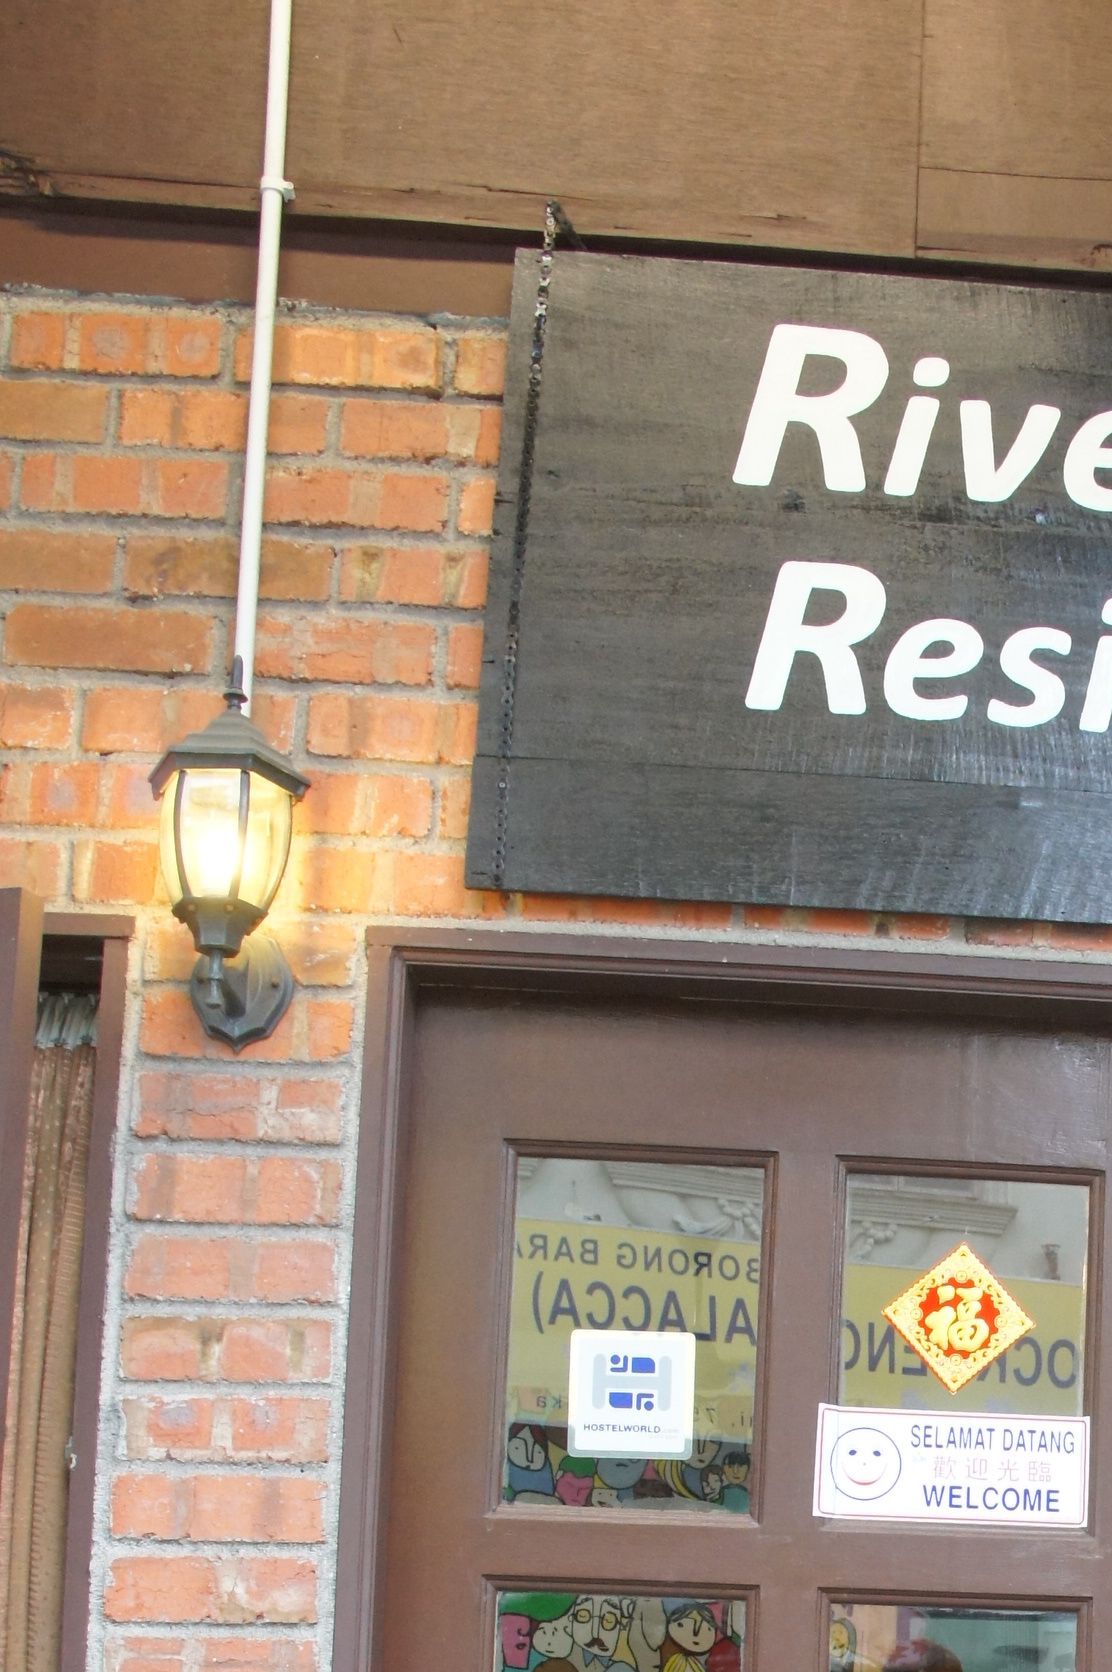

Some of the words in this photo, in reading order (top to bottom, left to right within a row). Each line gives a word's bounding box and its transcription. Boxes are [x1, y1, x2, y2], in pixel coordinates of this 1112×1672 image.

[925, 1284, 990, 1352] 福
[910, 1424, 996, 1450] SELAMAT
[1002, 1428, 1075, 1454] DATANG
[931, 1455, 1052, 1483] 歡迎光臨
[922, 1484, 1061, 1512] WELCOME
